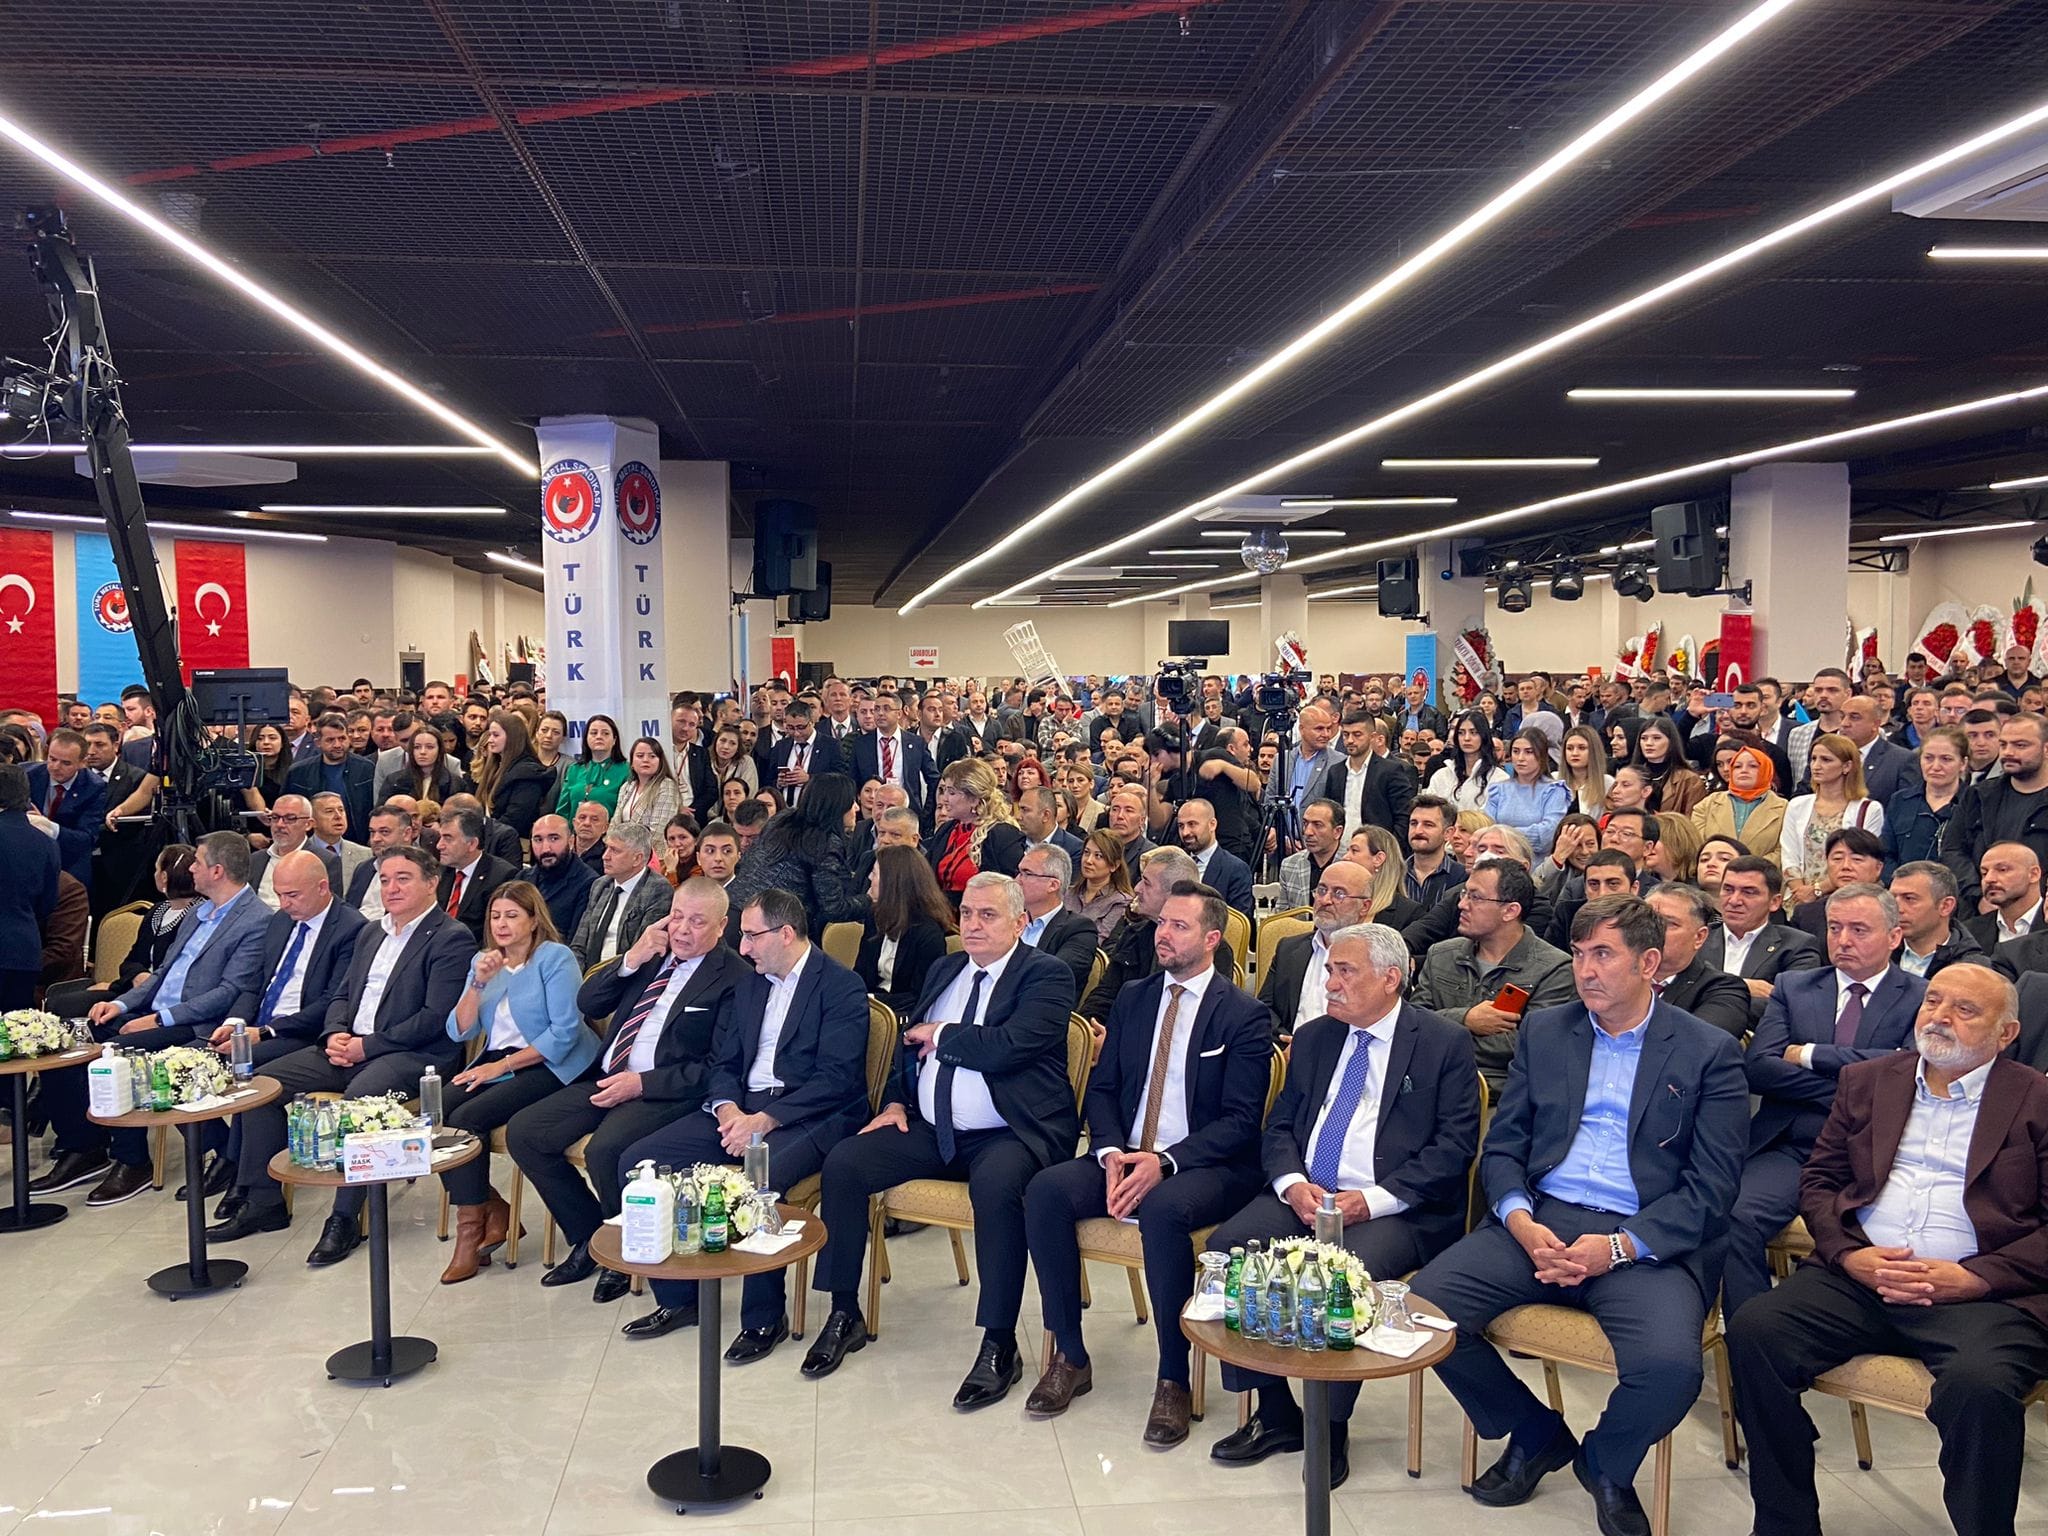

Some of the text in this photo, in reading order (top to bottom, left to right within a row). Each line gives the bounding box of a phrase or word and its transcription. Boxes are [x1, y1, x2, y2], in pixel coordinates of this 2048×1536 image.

[543, 463, 571, 484] METAL
[563, 563, 585, 681] TÜRK
[635, 565, 656, 682] TÜRK
